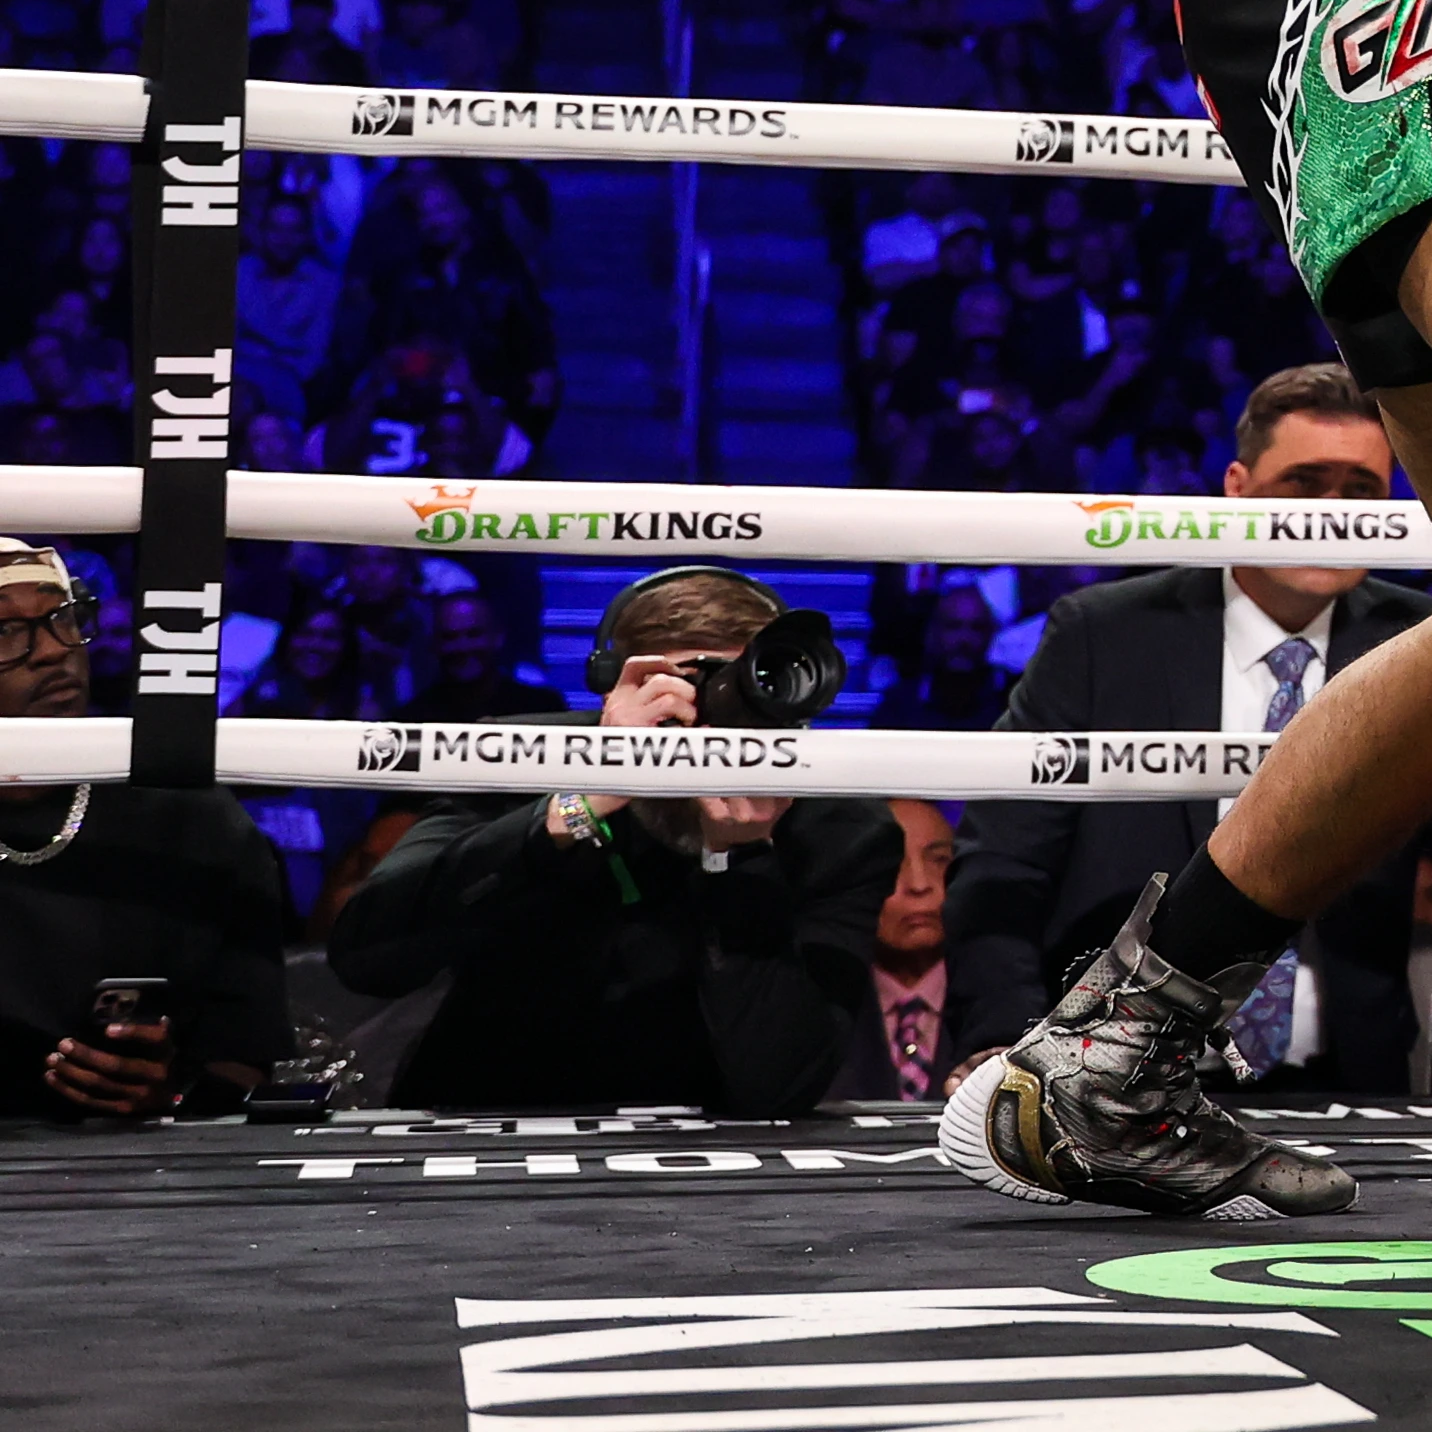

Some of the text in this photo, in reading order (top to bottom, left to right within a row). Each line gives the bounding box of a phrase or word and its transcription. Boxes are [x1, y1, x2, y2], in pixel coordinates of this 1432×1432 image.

[425, 98, 788, 140] MGM REWARDS
[1086, 125, 1189, 159] MGM
[161, 116, 241, 227] TJH
[150, 348, 233, 460] TJH
[415, 509, 763, 545] DRAFTKINGS
[1086, 507, 1409, 549] DRAFTKINGS
[138, 582, 222, 696] TJH
[433, 729, 799, 770] MGM REWARDS
[1101, 742, 1207, 775] MGM
